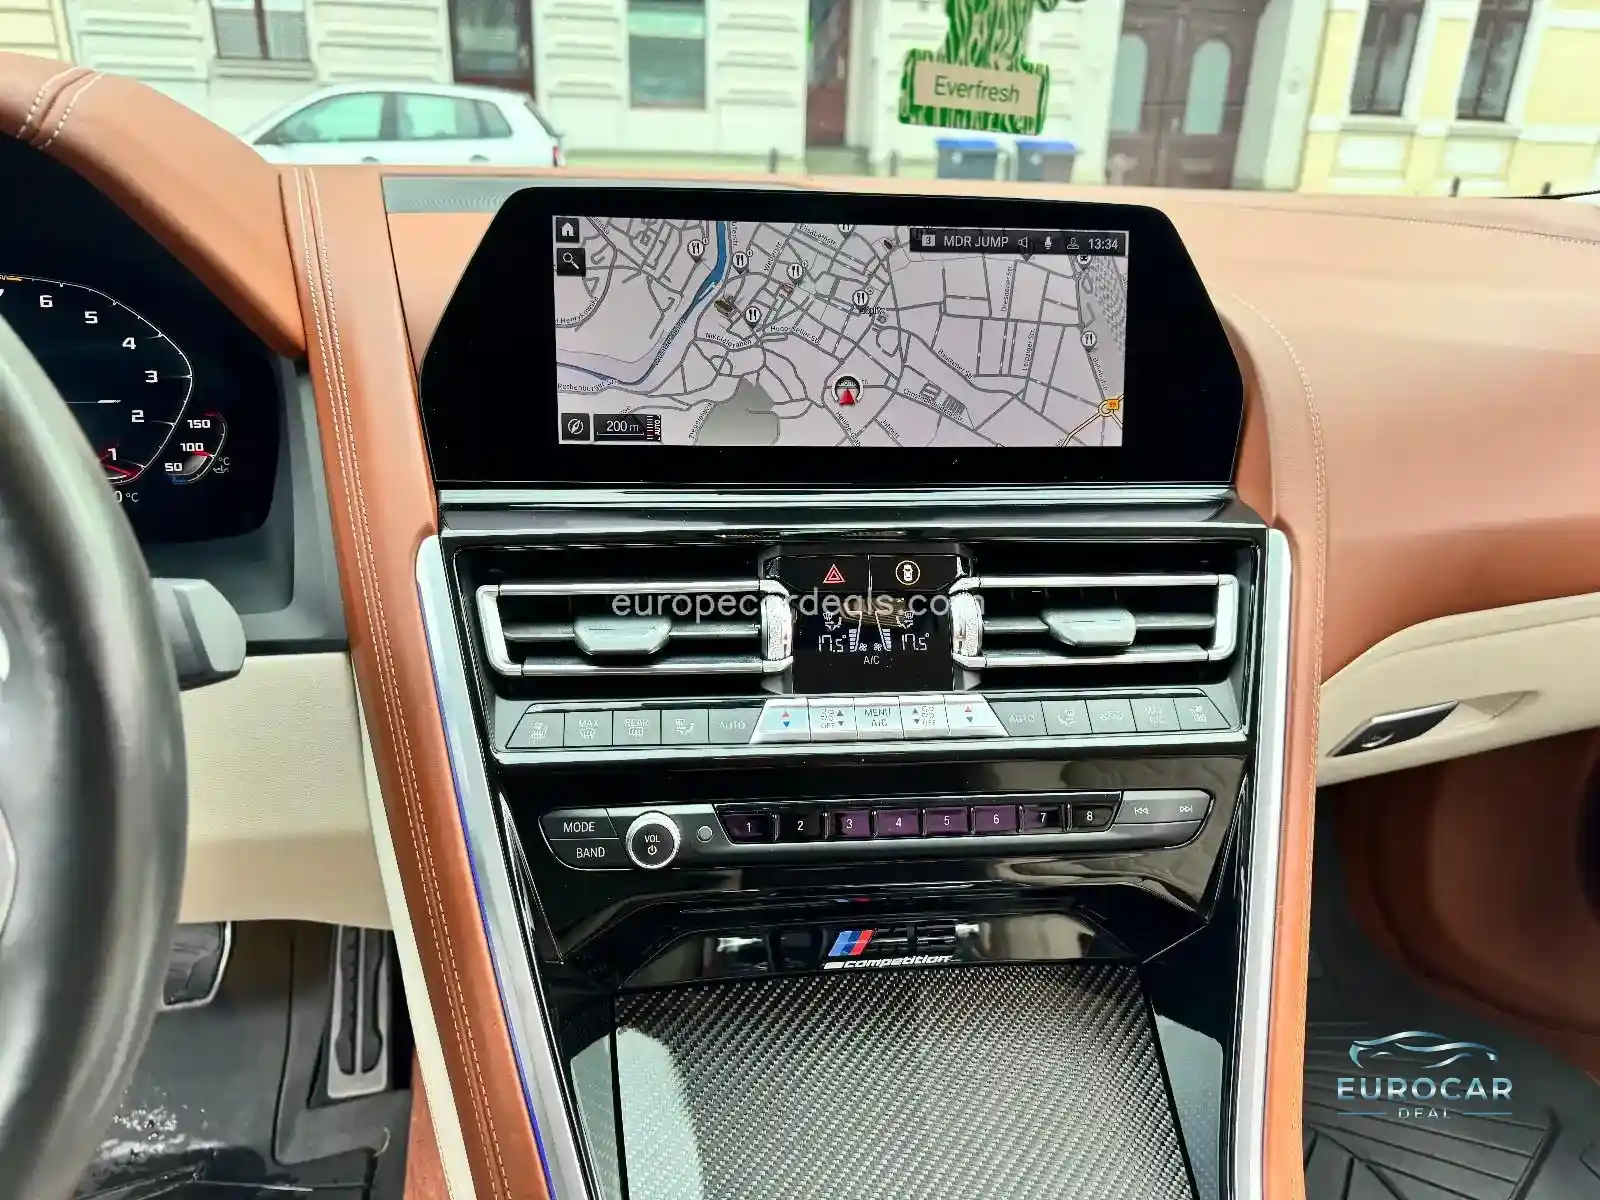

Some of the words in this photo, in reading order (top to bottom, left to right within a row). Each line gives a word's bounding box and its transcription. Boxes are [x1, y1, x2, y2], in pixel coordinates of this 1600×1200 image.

[934, 75, 1020, 104] Everfresh
[943, 235, 972, 247] MDR
[974, 236, 1009, 248] JUMP
[1088, 238, 1118, 250] 13:34
[39, 294, 53, 308] 6
[84, 311, 98, 324] 5
[122, 336, 137, 350] 4
[145, 370, 158, 383] 3
[131, 409, 145, 423] 2
[187, 419, 211, 429] 150
[606, 420, 628, 432] 200
[629, 423, 639, 432] m
[180, 442, 204, 452] 100
[107, 447, 118, 461] 1
[164, 462, 183, 472] 50
[863, 655, 880, 665] A/C
[864, 707, 892, 718] MENU
[577, 718, 600, 729] MAX
[623, 717, 649, 727] REAR
[718, 720, 746, 731] AUTO
[870, 718, 889, 728] A/C
[943, 815, 950, 826] 5
[993, 814, 1000, 825] 6
[1040, 812, 1047, 823] 7
[1086, 810, 1094, 821] 8
[563, 821, 596, 833] MODE
[746, 822, 753, 833] 1
[797, 820, 804, 831] 2
[846, 818, 853, 830] 3
[895, 817, 902, 828] 4
[644, 834, 661, 844] VOL
[576, 846, 606, 859] BAND
[842, 954, 954, 969] competition
